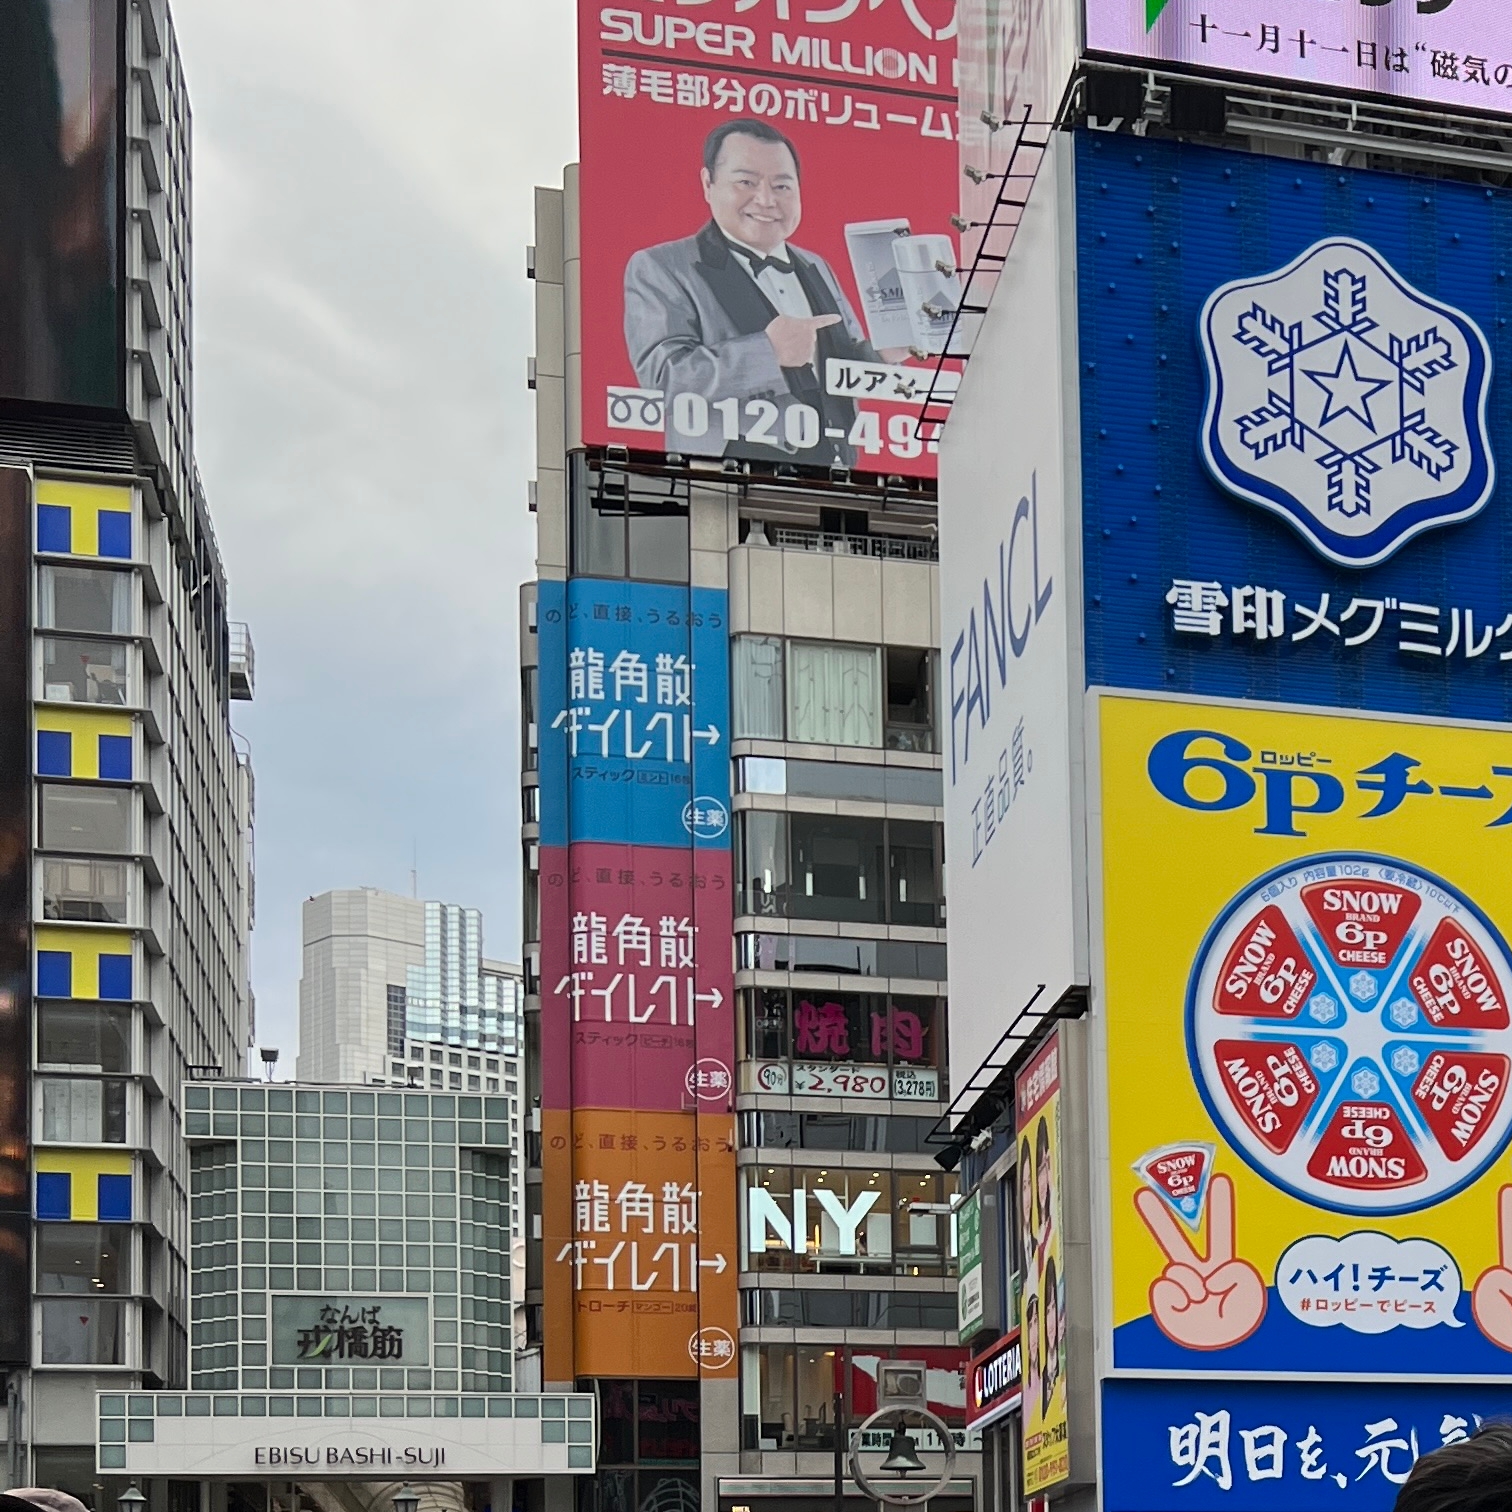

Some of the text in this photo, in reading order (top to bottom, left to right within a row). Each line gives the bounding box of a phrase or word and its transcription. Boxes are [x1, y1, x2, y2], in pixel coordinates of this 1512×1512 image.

[599, 8, 755, 59] SUPER
[771, 32, 937, 84] MILLION
[601, 62, 960, 141] 薄毛部分のボリューム
[950, 467, 1053, 786] FANCL
[570, 647, 696, 707] 龍角散
[1260, 750, 1332, 768] ロッピー
[1323, 889, 1403, 914] SNOW
[1345, 913, 1381, 923] BRAND
[572, 911, 699, 969] 龍角散
[1225, 920, 1277, 1000] SNOW
[1338, 950, 1387, 964] CHEESE
[1282, 969, 1314, 1014] CHEESE
[1446, 937, 1502, 1012] SNOW
[1412, 976, 1445, 1023] CHEESE
[1283, 1046, 1316, 1094] CHEESE
[1415, 1054, 1445, 1100] CHEESE
[1223, 1057, 1282, 1134] SNOW
[1342, 1106, 1390, 1120] CHEESE
[1451, 1069, 1500, 1147] SNOW
[1156, 1154, 1196, 1174] SNOW
[1325, 1156, 1406, 1180] SNOW
[575, 1179, 703, 1235] 龍角散
[320, 1304, 382, 1325] なんば
[577, 1301, 631, 1313] トローチ
[984, 1344, 1022, 1397] LOTTERIA
[254, 1447, 320, 1466] EBISU
